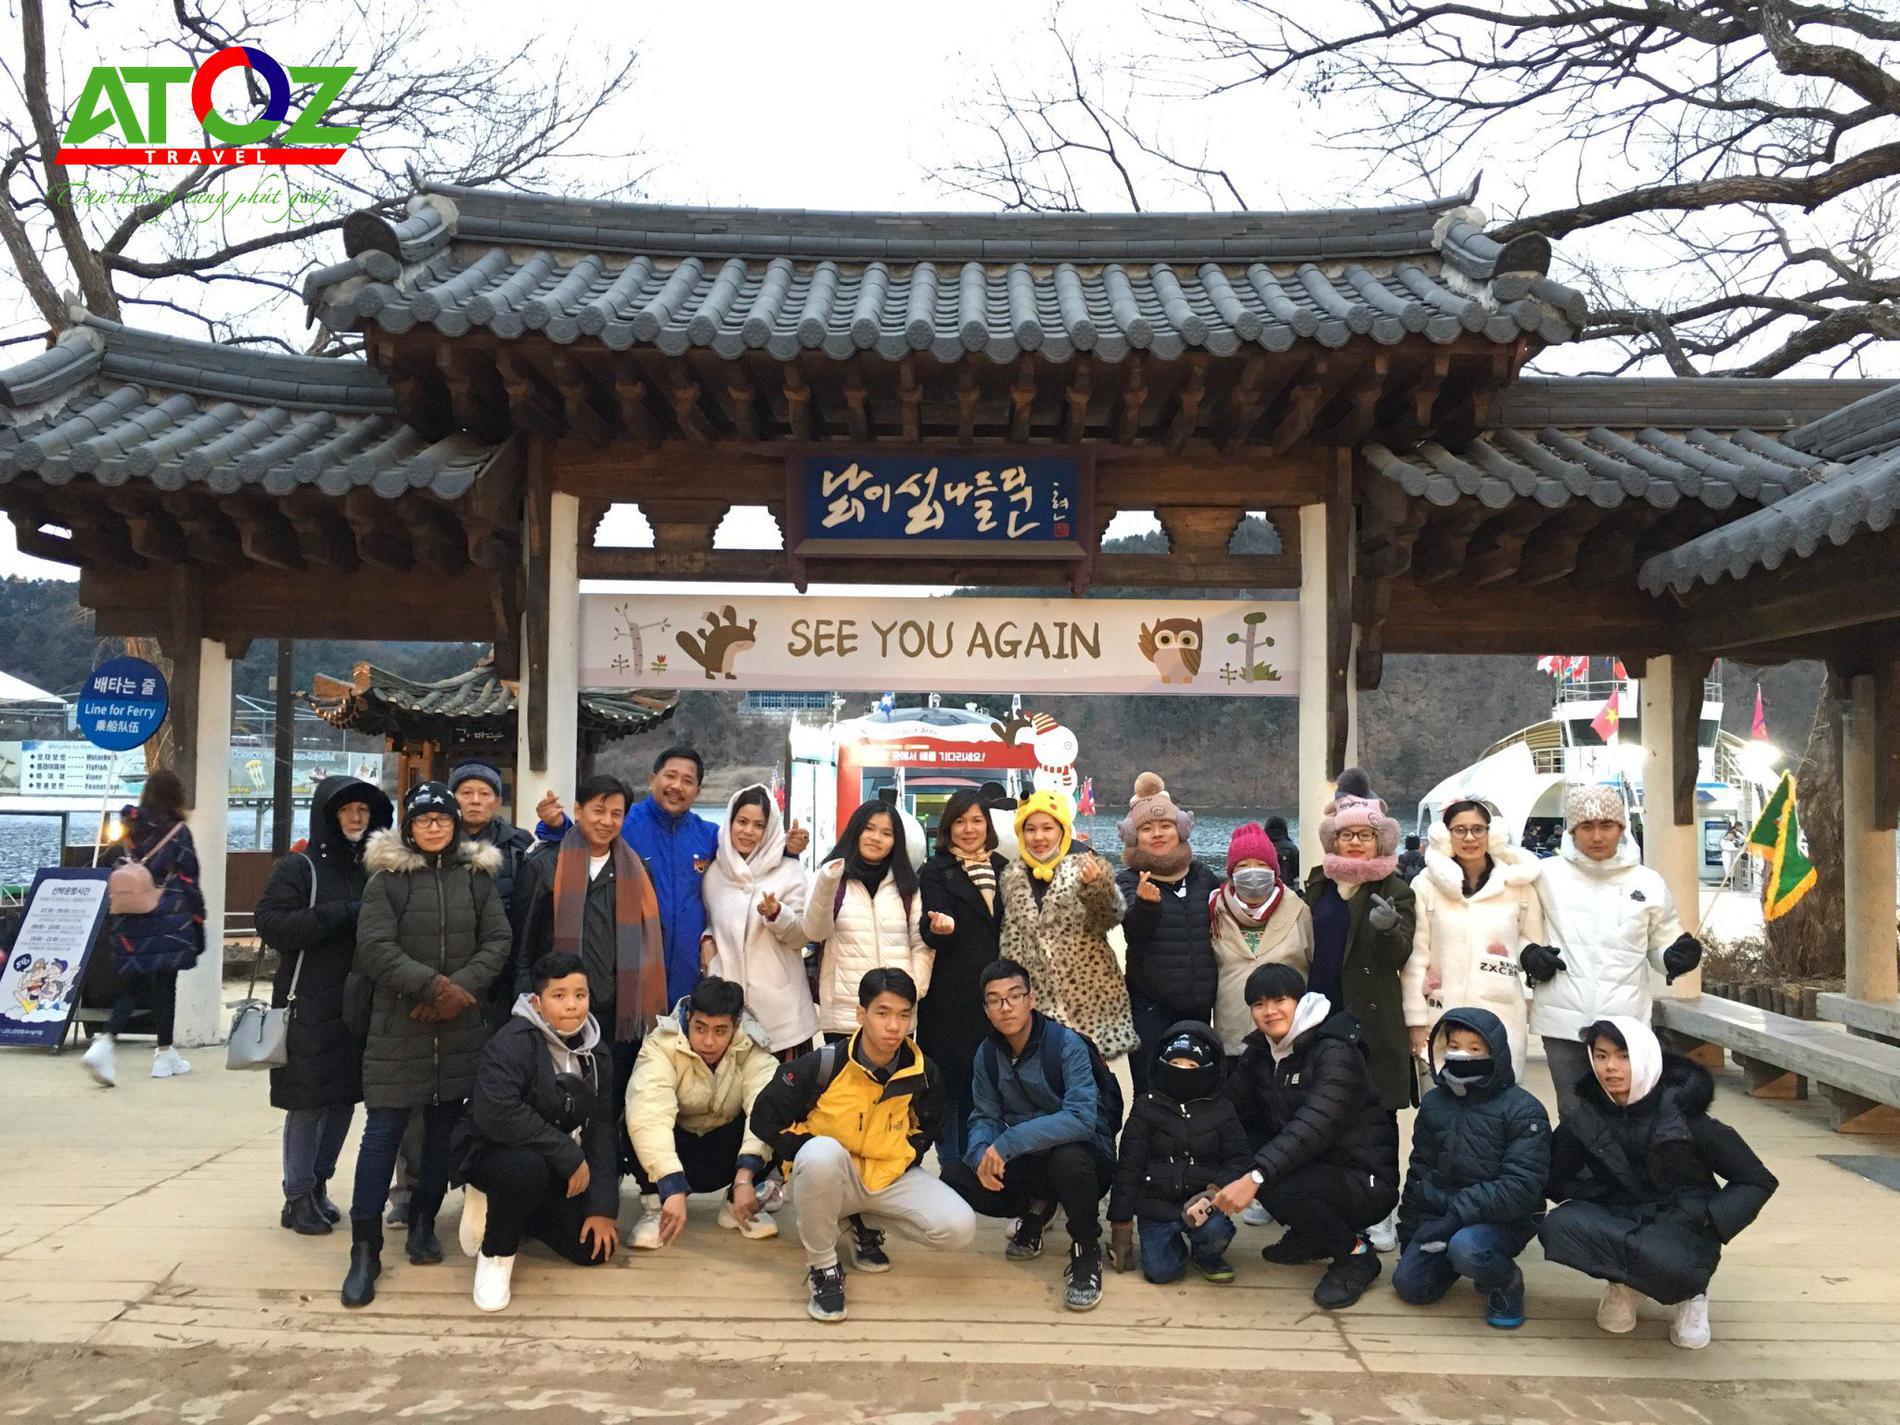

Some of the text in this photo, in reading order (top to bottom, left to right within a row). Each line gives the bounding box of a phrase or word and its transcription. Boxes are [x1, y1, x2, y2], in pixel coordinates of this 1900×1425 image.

[787, 619, 1101, 659] SEE YOU AGAIN
[93, 675, 137, 694] 배타는
[84, 703, 156, 720] Line for Ferry
